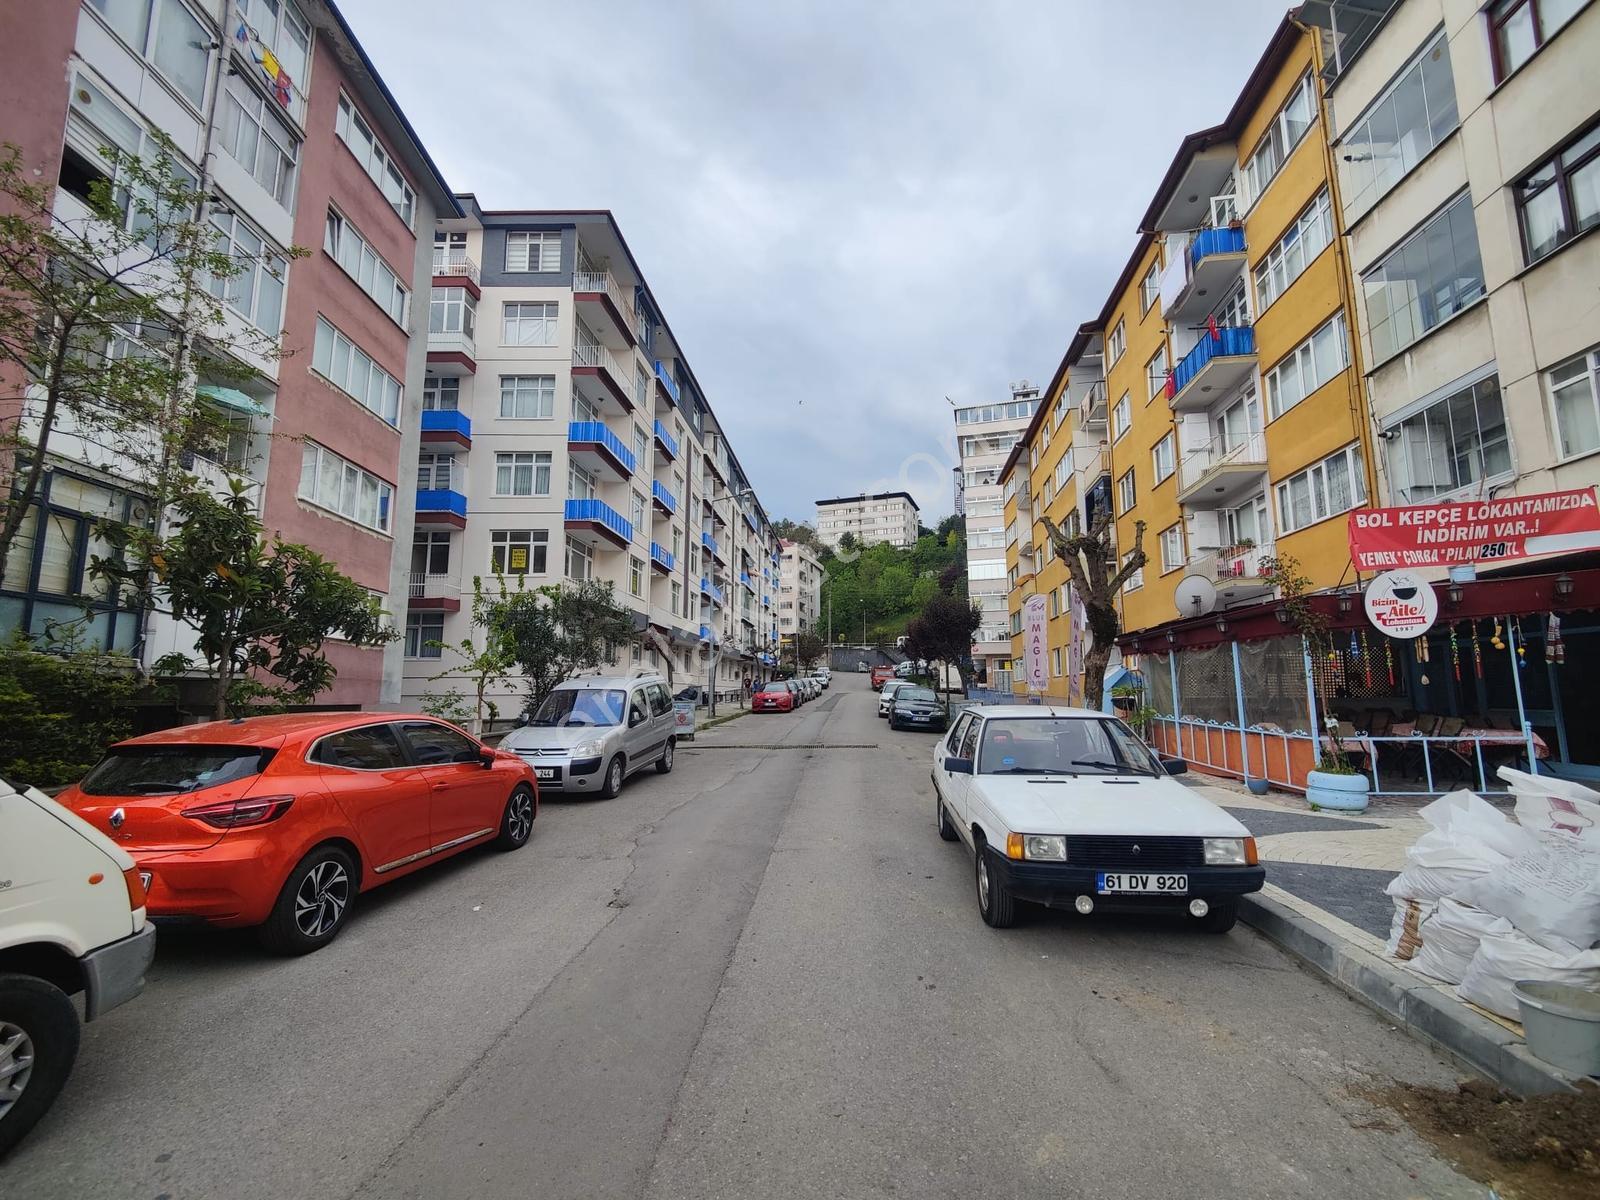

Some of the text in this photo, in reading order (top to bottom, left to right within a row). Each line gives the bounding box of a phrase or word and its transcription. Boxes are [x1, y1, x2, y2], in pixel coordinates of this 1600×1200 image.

[1356, 493, 1596, 528] BOL KEPÇE LOKANTAMIZDA
[1417, 524, 1489, 544] İNDİRİM
[1372, 598, 1398, 607] Bizim
[1389, 604, 1418, 617] Aile
[1031, 623, 1041, 678] MAGIC
[1105, 875, 1187, 890] 61 DV 920
